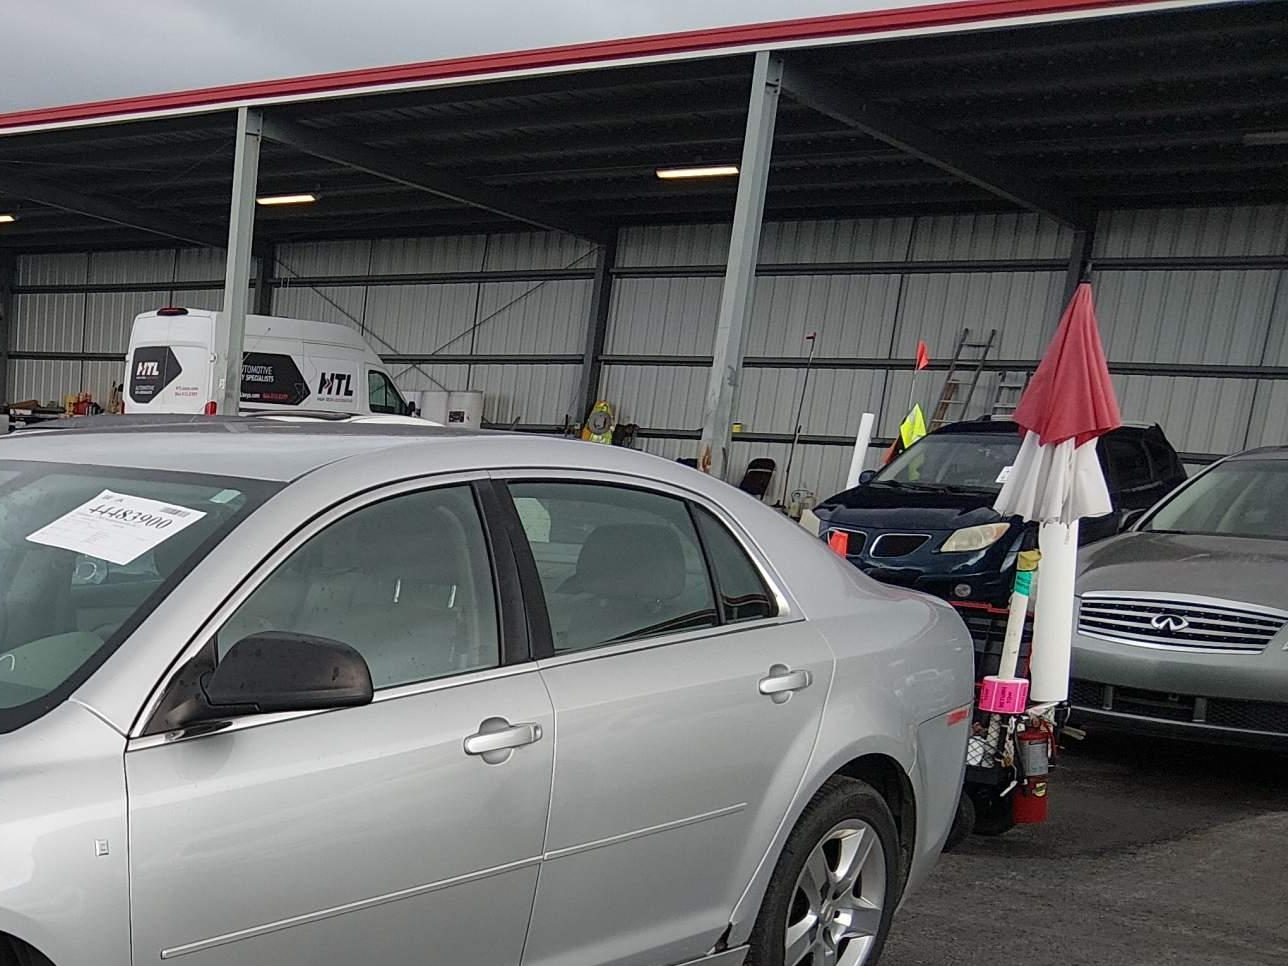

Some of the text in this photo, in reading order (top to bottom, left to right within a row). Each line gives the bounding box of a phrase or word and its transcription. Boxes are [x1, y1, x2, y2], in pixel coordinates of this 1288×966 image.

[136, 361, 160, 376] HTL
[242, 365, 273, 375] TOMOTIVE
[318, 372, 354, 396] HTL
[89, 504, 174, 529] 44483900
